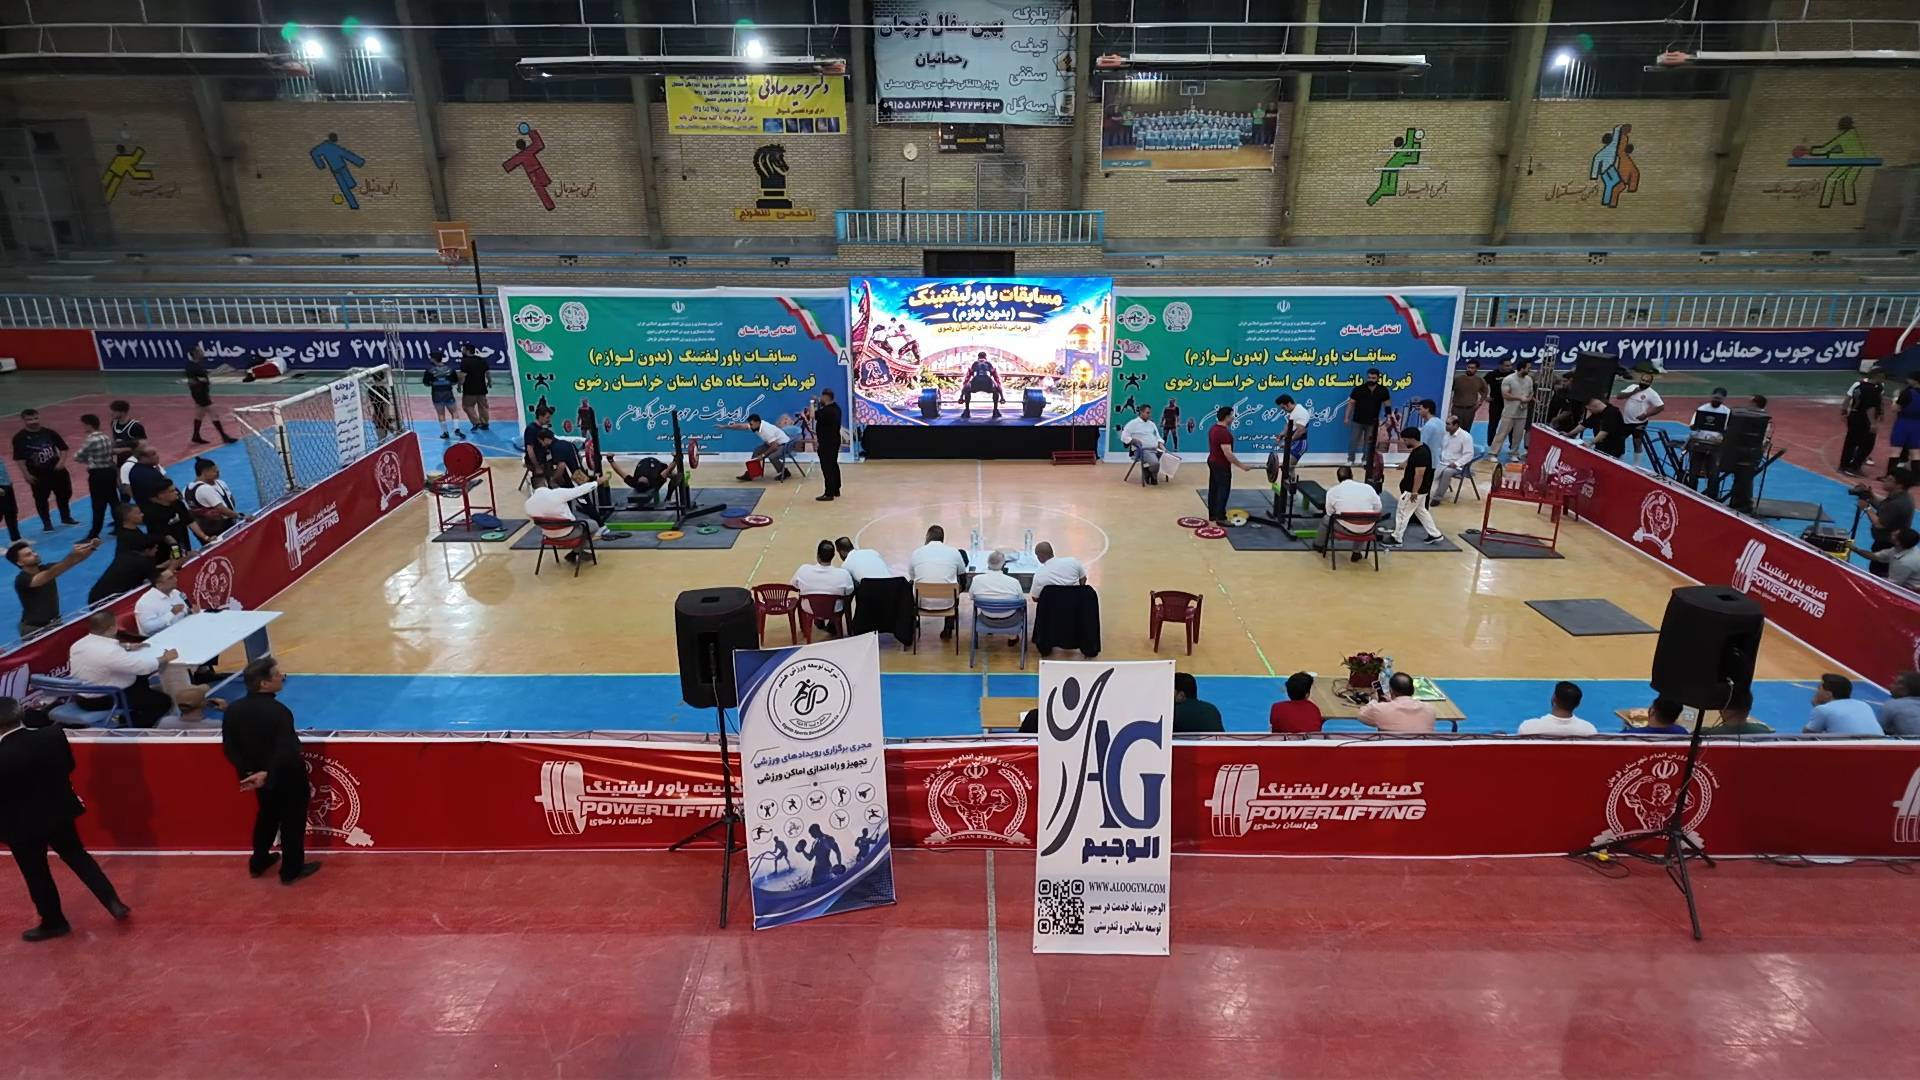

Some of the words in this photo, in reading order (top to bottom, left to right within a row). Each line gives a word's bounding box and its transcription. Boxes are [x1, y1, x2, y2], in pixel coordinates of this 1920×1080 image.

[879, 11, 930, 39] قوچان
[931, 13, 968, 37] سفال
[1011, 38, 1048, 57] تیغه
[915, 52, 968, 69] رحمانیان
[1000, 286, 1063, 308] مسابقات
[101, 338, 184, 360] ۴۷۲۱۱۱۱۱
[300, 340, 341, 363] کالای
[743, 348, 797, 366] مسابقات
[839, 350, 850, 364] A
[1111, 350, 1123, 367] B
[1341, 348, 1397, 366] مسابقات
[1456, 340, 1517, 364] رحمانیا
[1700, 339, 1772, 364] رحمانیان
[1774, 343, 1815, 364] چوب
[1815, 339, 1865, 363] کالای
[574, 373, 609, 392] رضوی
[611, 373, 664, 392] خراسان
[665, 373, 698, 392] استان
[700, 373, 724, 392] های
[725, 373, 770, 391] باشگاه
[771, 372, 817, 392] قهرمانی
[1164, 373, 1201, 392] رضوی
[1201, 373, 1255, 392] خراسان
[1256, 373, 1290, 392] استان
[1291, 373, 1316, 392] های
[1750, 573, 1826, 619] POWERLIFTING
[822, 744, 849, 757] برگزاری
[849, 741, 873, 753] مجری
[753, 756, 780, 769] ورزشی
[806, 763, 830, 776] اندازی
[845, 757, 868, 770] تجهیز
[756, 772, 783, 785] ورزشی
[783, 767, 806, 780] اماکن
[1367, 781, 1425, 799] کمیته
[589, 816, 617, 827] رضوی
[618, 816, 653, 826] خراسان
[1248, 805, 1428, 821] POWERLIFTING
[1252, 821, 1281, 831] رضوی
[1282, 821, 1319, 831] خراسان
[1081, 835, 1161, 866] الوجیم
[1088, 881, 1166, 894] WWW.ALOOGYM.COM
